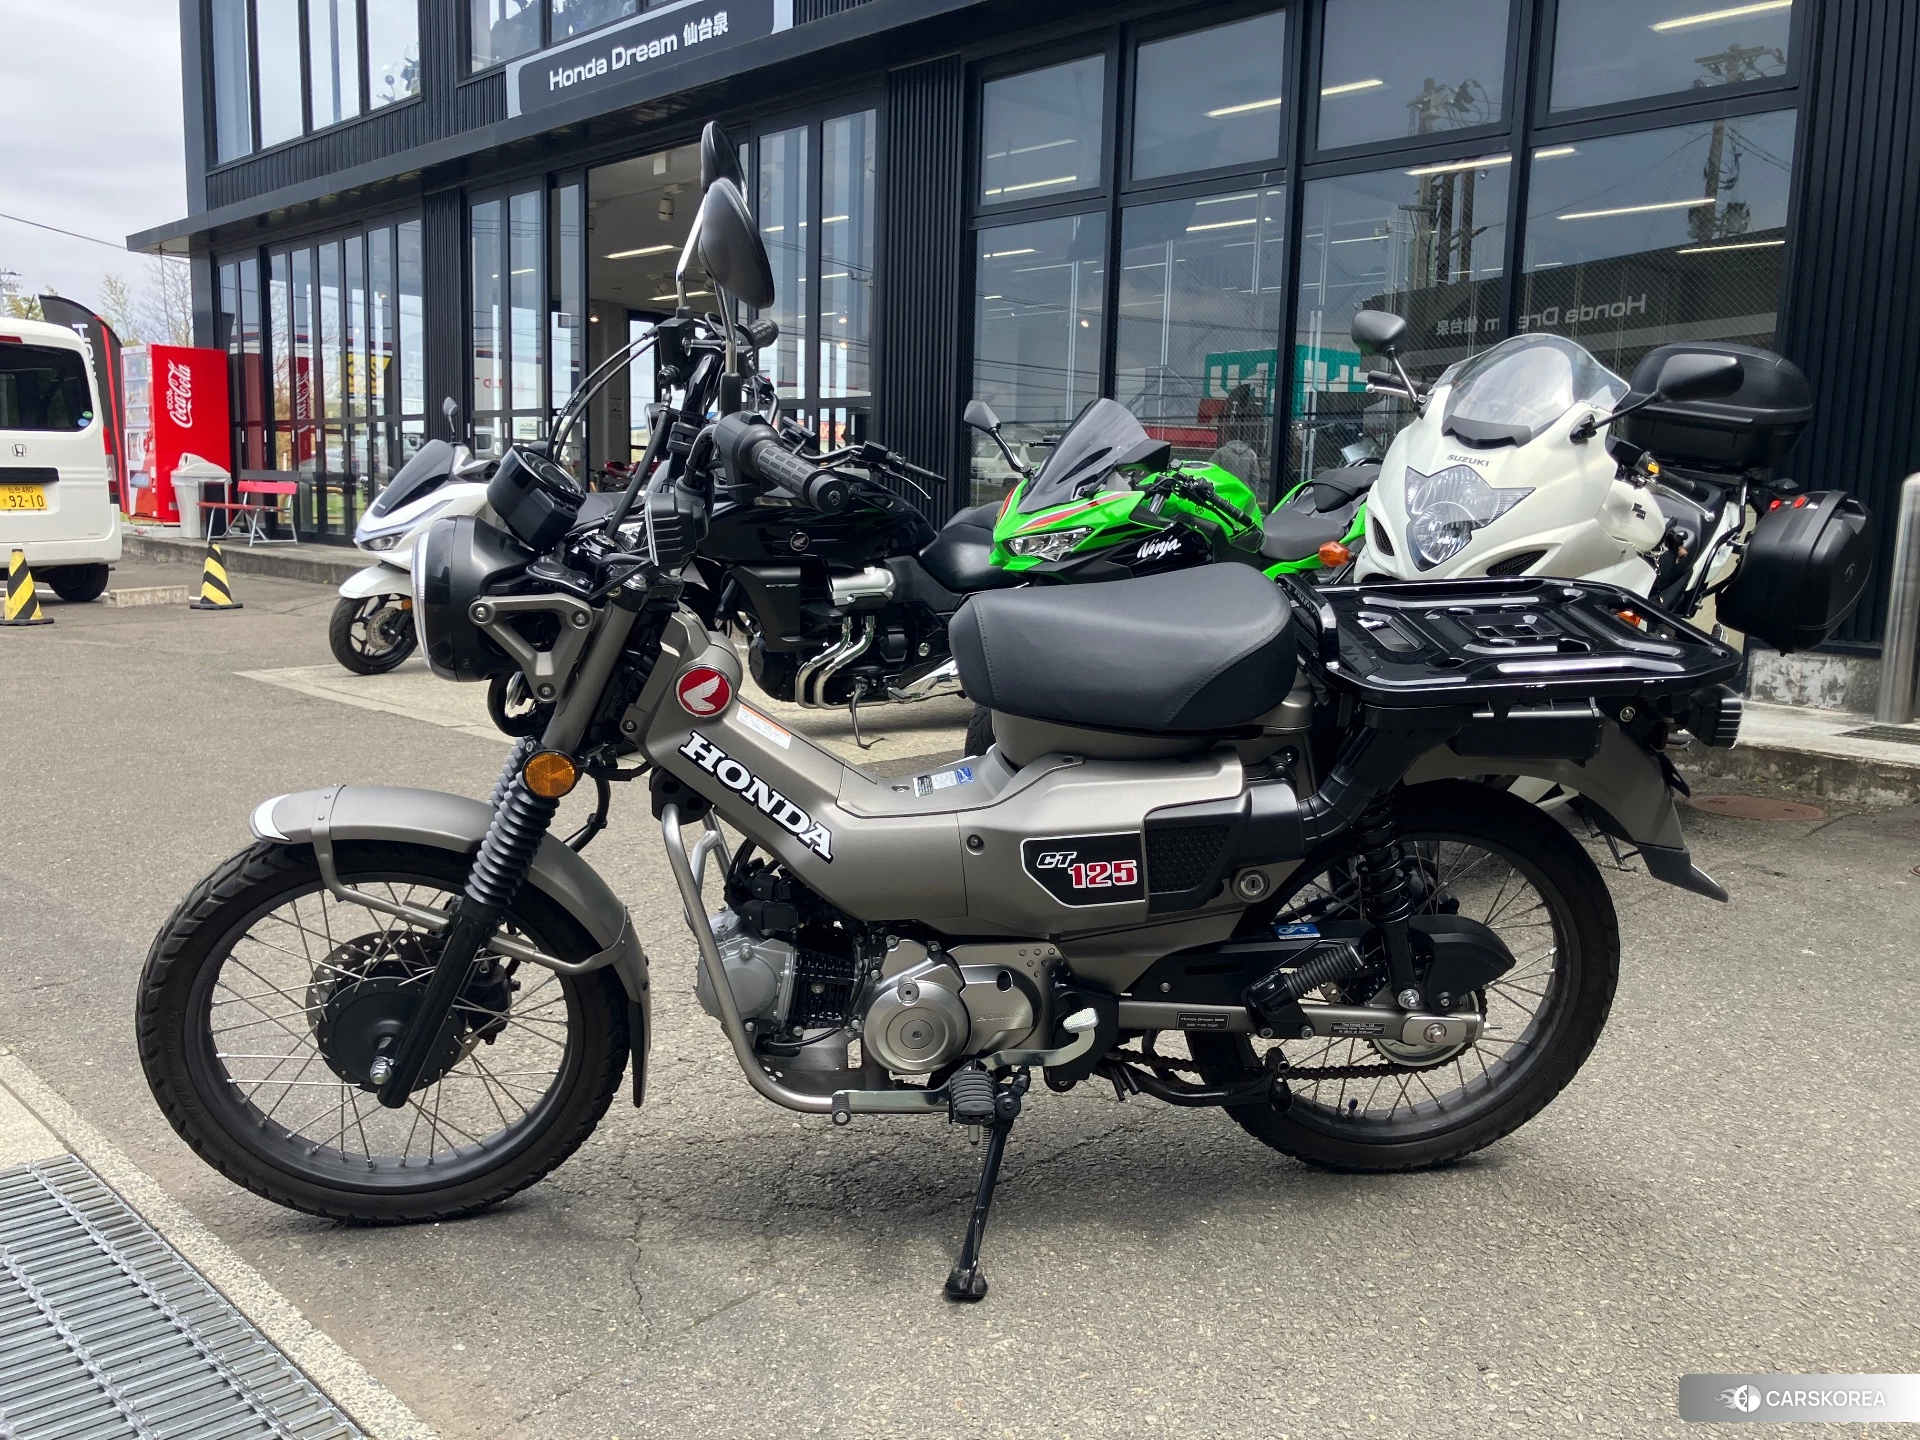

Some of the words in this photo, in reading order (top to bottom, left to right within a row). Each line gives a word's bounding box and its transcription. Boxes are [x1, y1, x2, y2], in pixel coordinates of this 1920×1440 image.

[549, 57, 608, 91] Honda
[611, 34, 678, 71] Dream
[683, 11, 729, 47] 仙台泉
[1446, 454, 1490, 467] SUZUKI
[9, 494, 45, 508] 92-10
[1136, 534, 1182, 560] Ninja
[679, 730, 833, 863] HONDA
[1036, 851, 1078, 868] CT
[1067, 859, 1138, 889] 125
